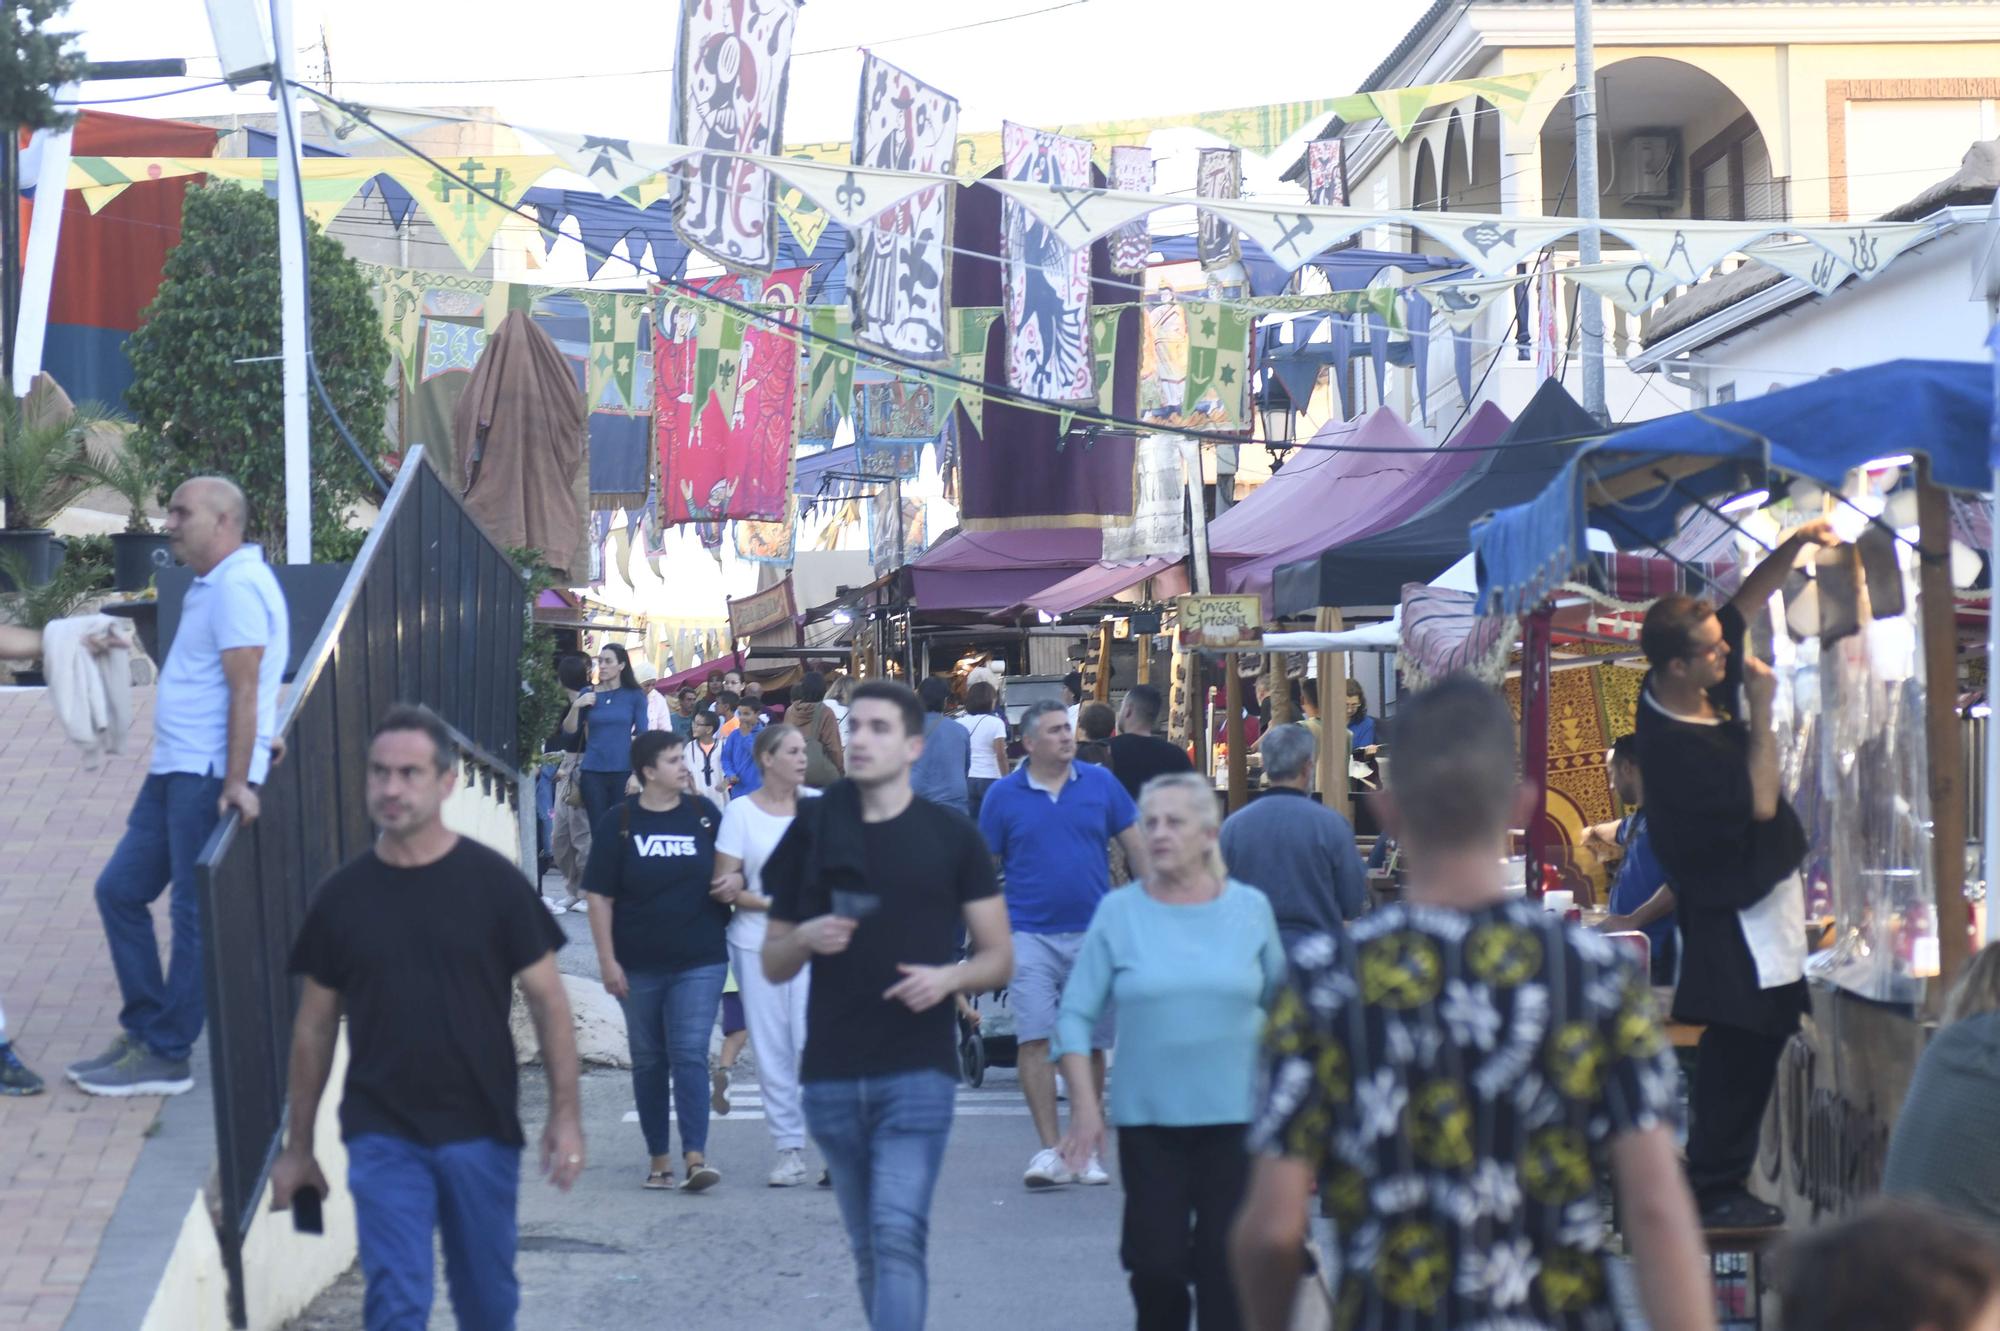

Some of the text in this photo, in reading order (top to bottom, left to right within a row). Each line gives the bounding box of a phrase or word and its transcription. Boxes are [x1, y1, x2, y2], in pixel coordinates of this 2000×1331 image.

[1186, 599, 1242, 616] Cerveza
[1186, 614, 1247, 629] Artesana
[633, 834, 697, 857] VANS
